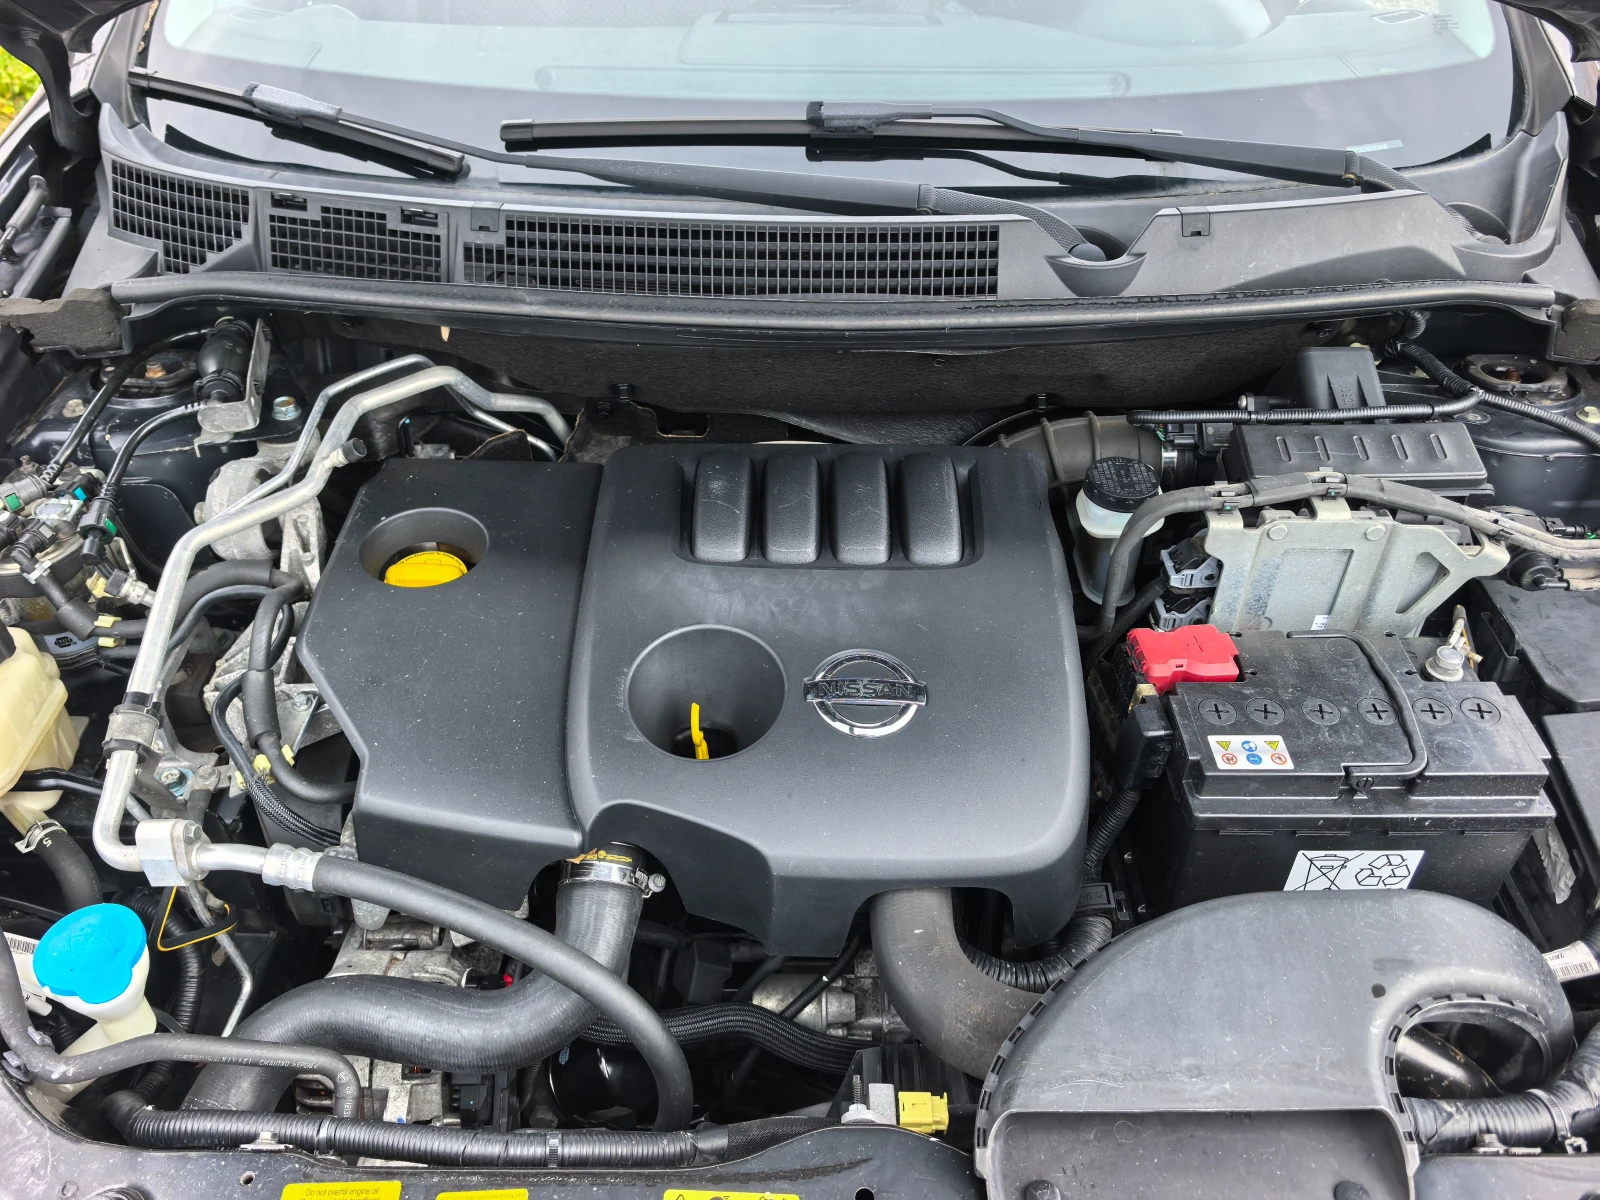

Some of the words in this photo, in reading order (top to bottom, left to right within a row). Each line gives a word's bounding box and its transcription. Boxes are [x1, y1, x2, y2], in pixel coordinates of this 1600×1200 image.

[818, 682, 911, 697] NISSAN
[305, 1188, 315, 1197] Do
[316, 1188, 327, 1196] not
[327, 1187, 349, 1196] overfill
[349, 1188, 371, 1197] engine
[371, 1186, 380, 1195] oil
